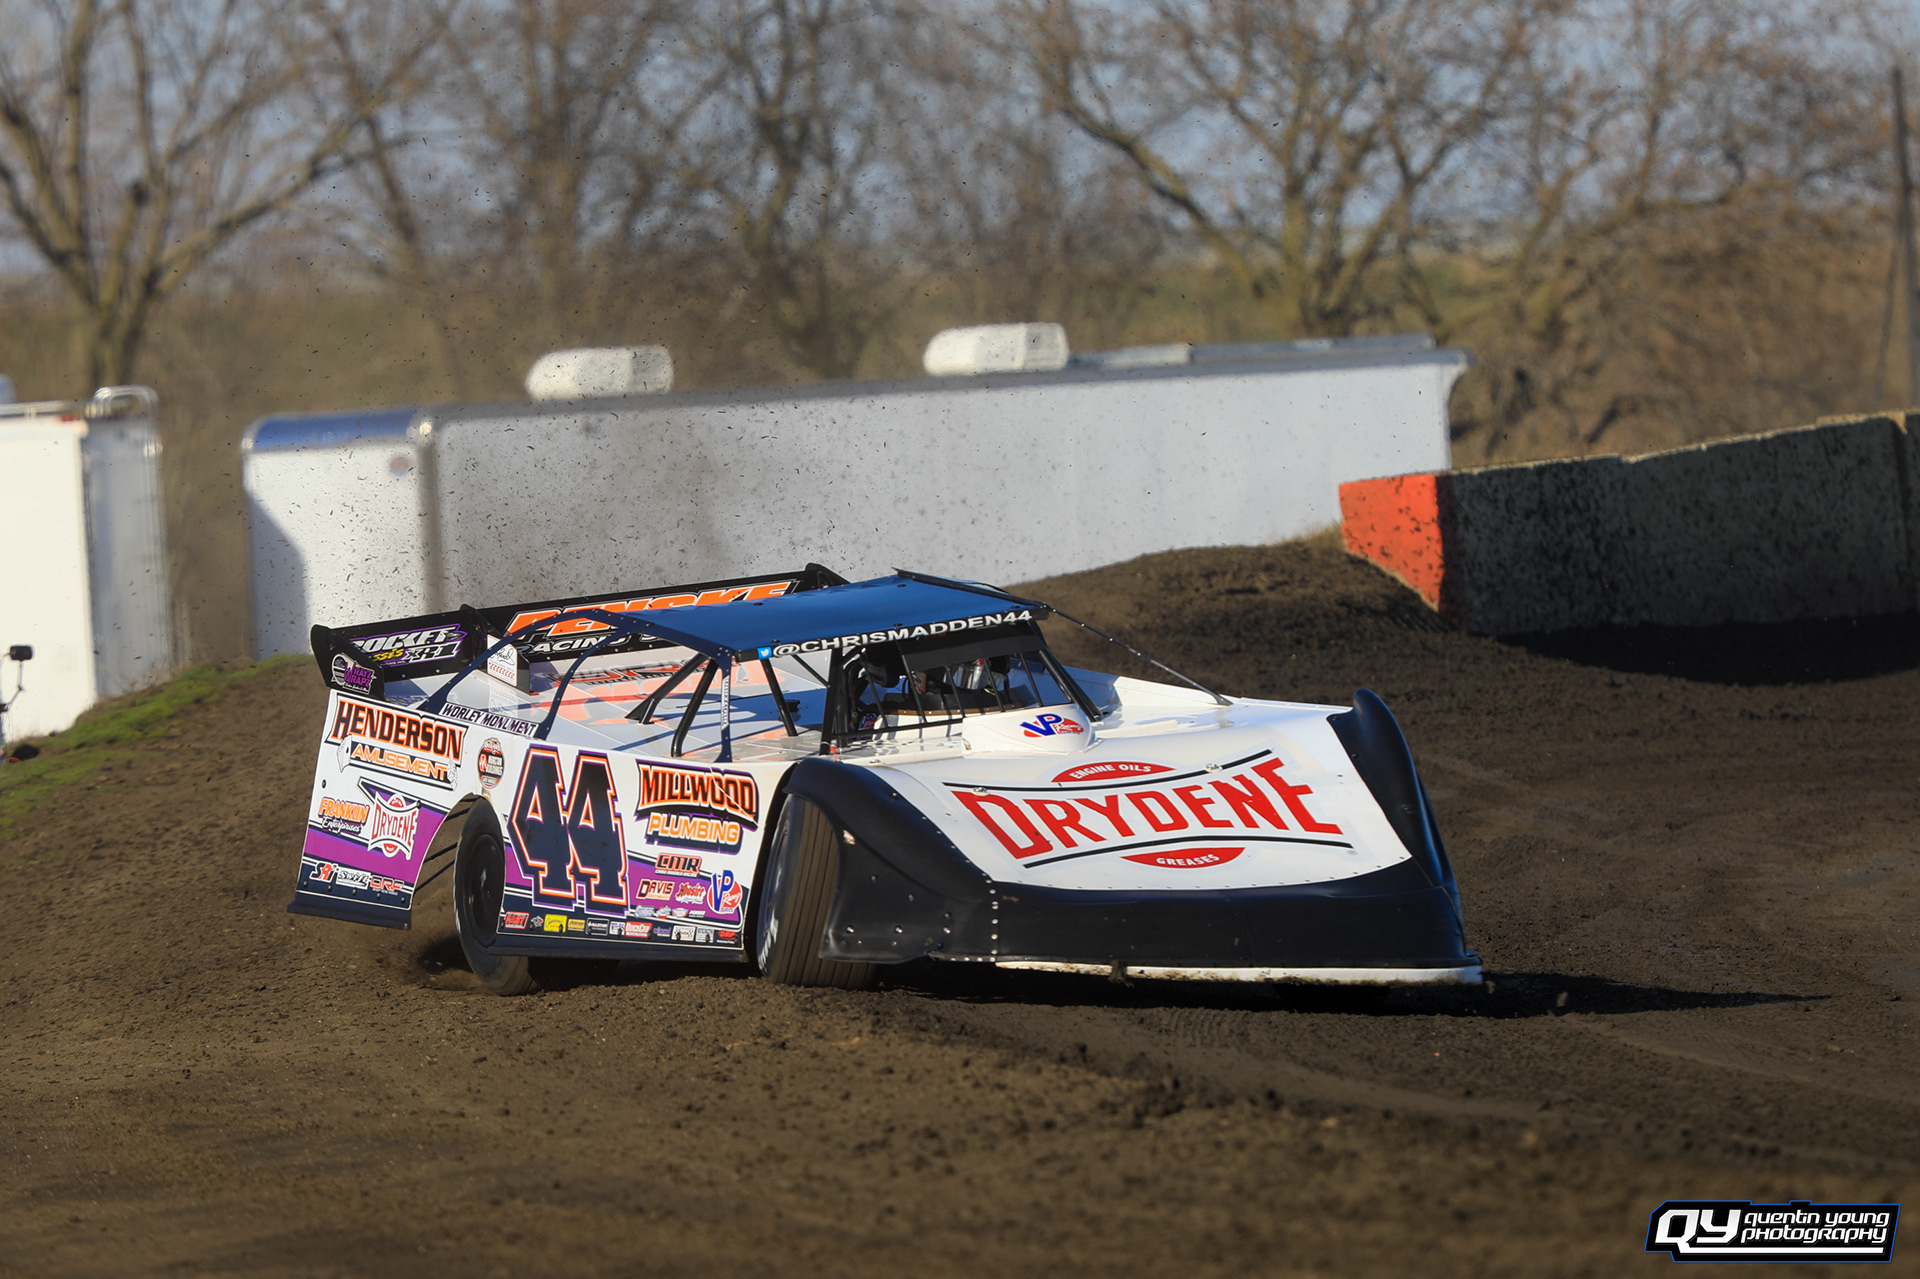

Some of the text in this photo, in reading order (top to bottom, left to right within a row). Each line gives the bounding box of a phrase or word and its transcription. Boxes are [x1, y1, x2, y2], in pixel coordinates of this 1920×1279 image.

[773, 610, 1032, 658] @CHRISMADDEN44
[331, 698, 464, 762] HENDERSON
[442, 703, 537, 737] WORLEY MONUMENT
[1020, 713, 1062, 736] VP
[351, 743, 449, 781] AMUSEMENT
[1069, 763, 1152, 780] ENGINE OILS
[638, 763, 757, 822] MILLWOOD
[951, 757, 1344, 860] DRYDENE
[318, 797, 370, 824] FRANKLIN
[321, 816, 361, 834] Enterprises
[371, 802, 417, 848] DRYDENE
[509, 746, 629, 909] 44
[646, 811, 742, 846] PLUMBING
[656, 854, 701, 873] CMR
[1156, 853, 1220, 867] GREASES
[637, 879, 674, 898] DAVIS
[712, 869, 735, 912] VP
[505, 913, 526, 926] FAST
